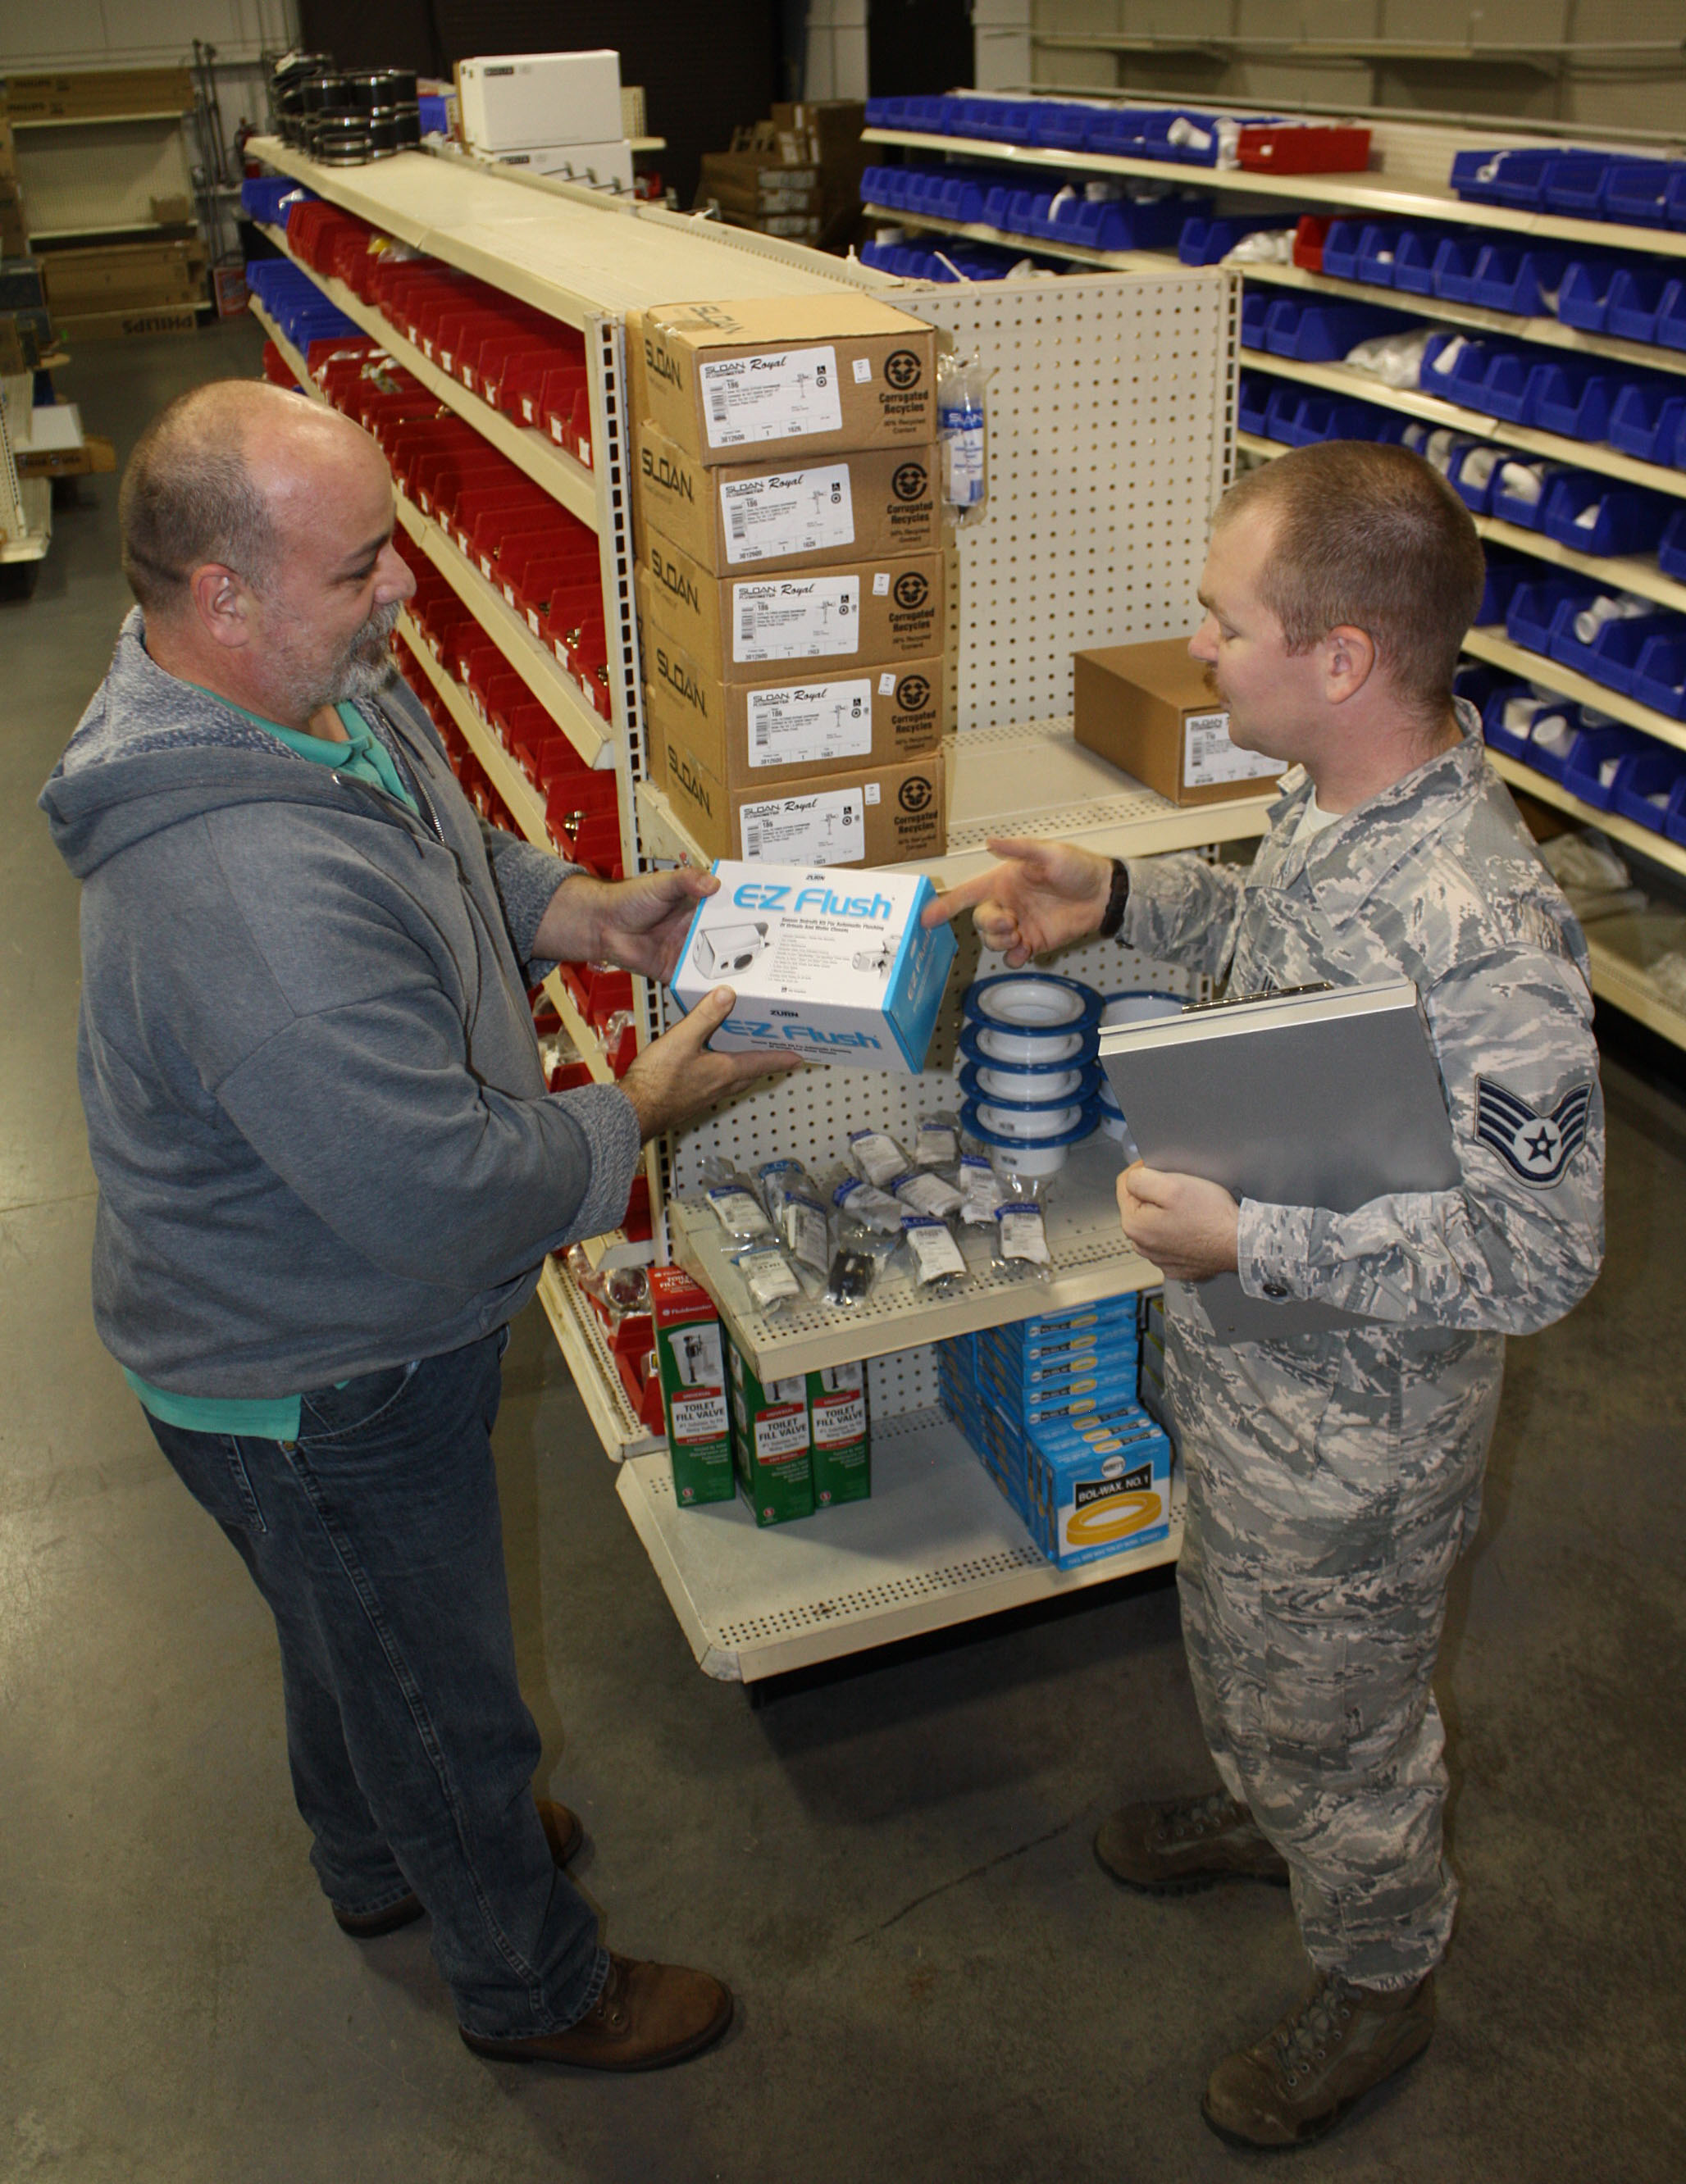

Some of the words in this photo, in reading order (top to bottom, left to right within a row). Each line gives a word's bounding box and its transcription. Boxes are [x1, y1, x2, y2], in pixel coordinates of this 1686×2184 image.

[645, 338, 682, 391] SLOAN
[704, 362, 745, 373] SLOAN
[750, 356, 787, 371] Royal
[879, 390, 928, 403] Corrugated
[884, 403, 924, 415] Recycles
[642, 448, 694, 504] SLOAN
[725, 481, 764, 492] SLOAN
[768, 474, 804, 489] Royal
[887, 501, 932, 514] Corrugated
[891, 512, 929, 525] Recycles
[652, 548, 700, 615] SLOAN
[738, 586, 777, 594] SLOAN
[781, 583, 814, 597] Royal
[889, 608, 934, 623] Corrugated
[893, 620, 930, 632] Recycles
[657, 648, 707, 718] SLOAN
[753, 692, 790, 703] SLOAN
[794, 689, 828, 702] Royal
[892, 710, 936, 724] Corrugated
[895, 722, 932, 734] Recycles
[668, 745, 712, 818] SLOAN
[744, 803, 781, 815] SLOAN
[784, 799, 818, 812] Royal
[894, 811, 937, 825] Corrugated
[899, 822, 935, 834] Recycles
[794, 888, 892, 920] Flush
[782, 1024, 883, 1050] Flush
[684, 1401, 714, 1412] TOILET
[826, 1404, 854, 1417] TOILET
[676, 1413, 695, 1422] FILL
[696, 1408, 724, 1419] VALVE
[817, 1418, 833, 1426] FILL
[837, 1410, 863, 1424] VALVE
[768, 1417, 798, 1431] TOILET
[759, 1432, 776, 1441] FILL
[779, 1424, 807, 1437] VALVE
